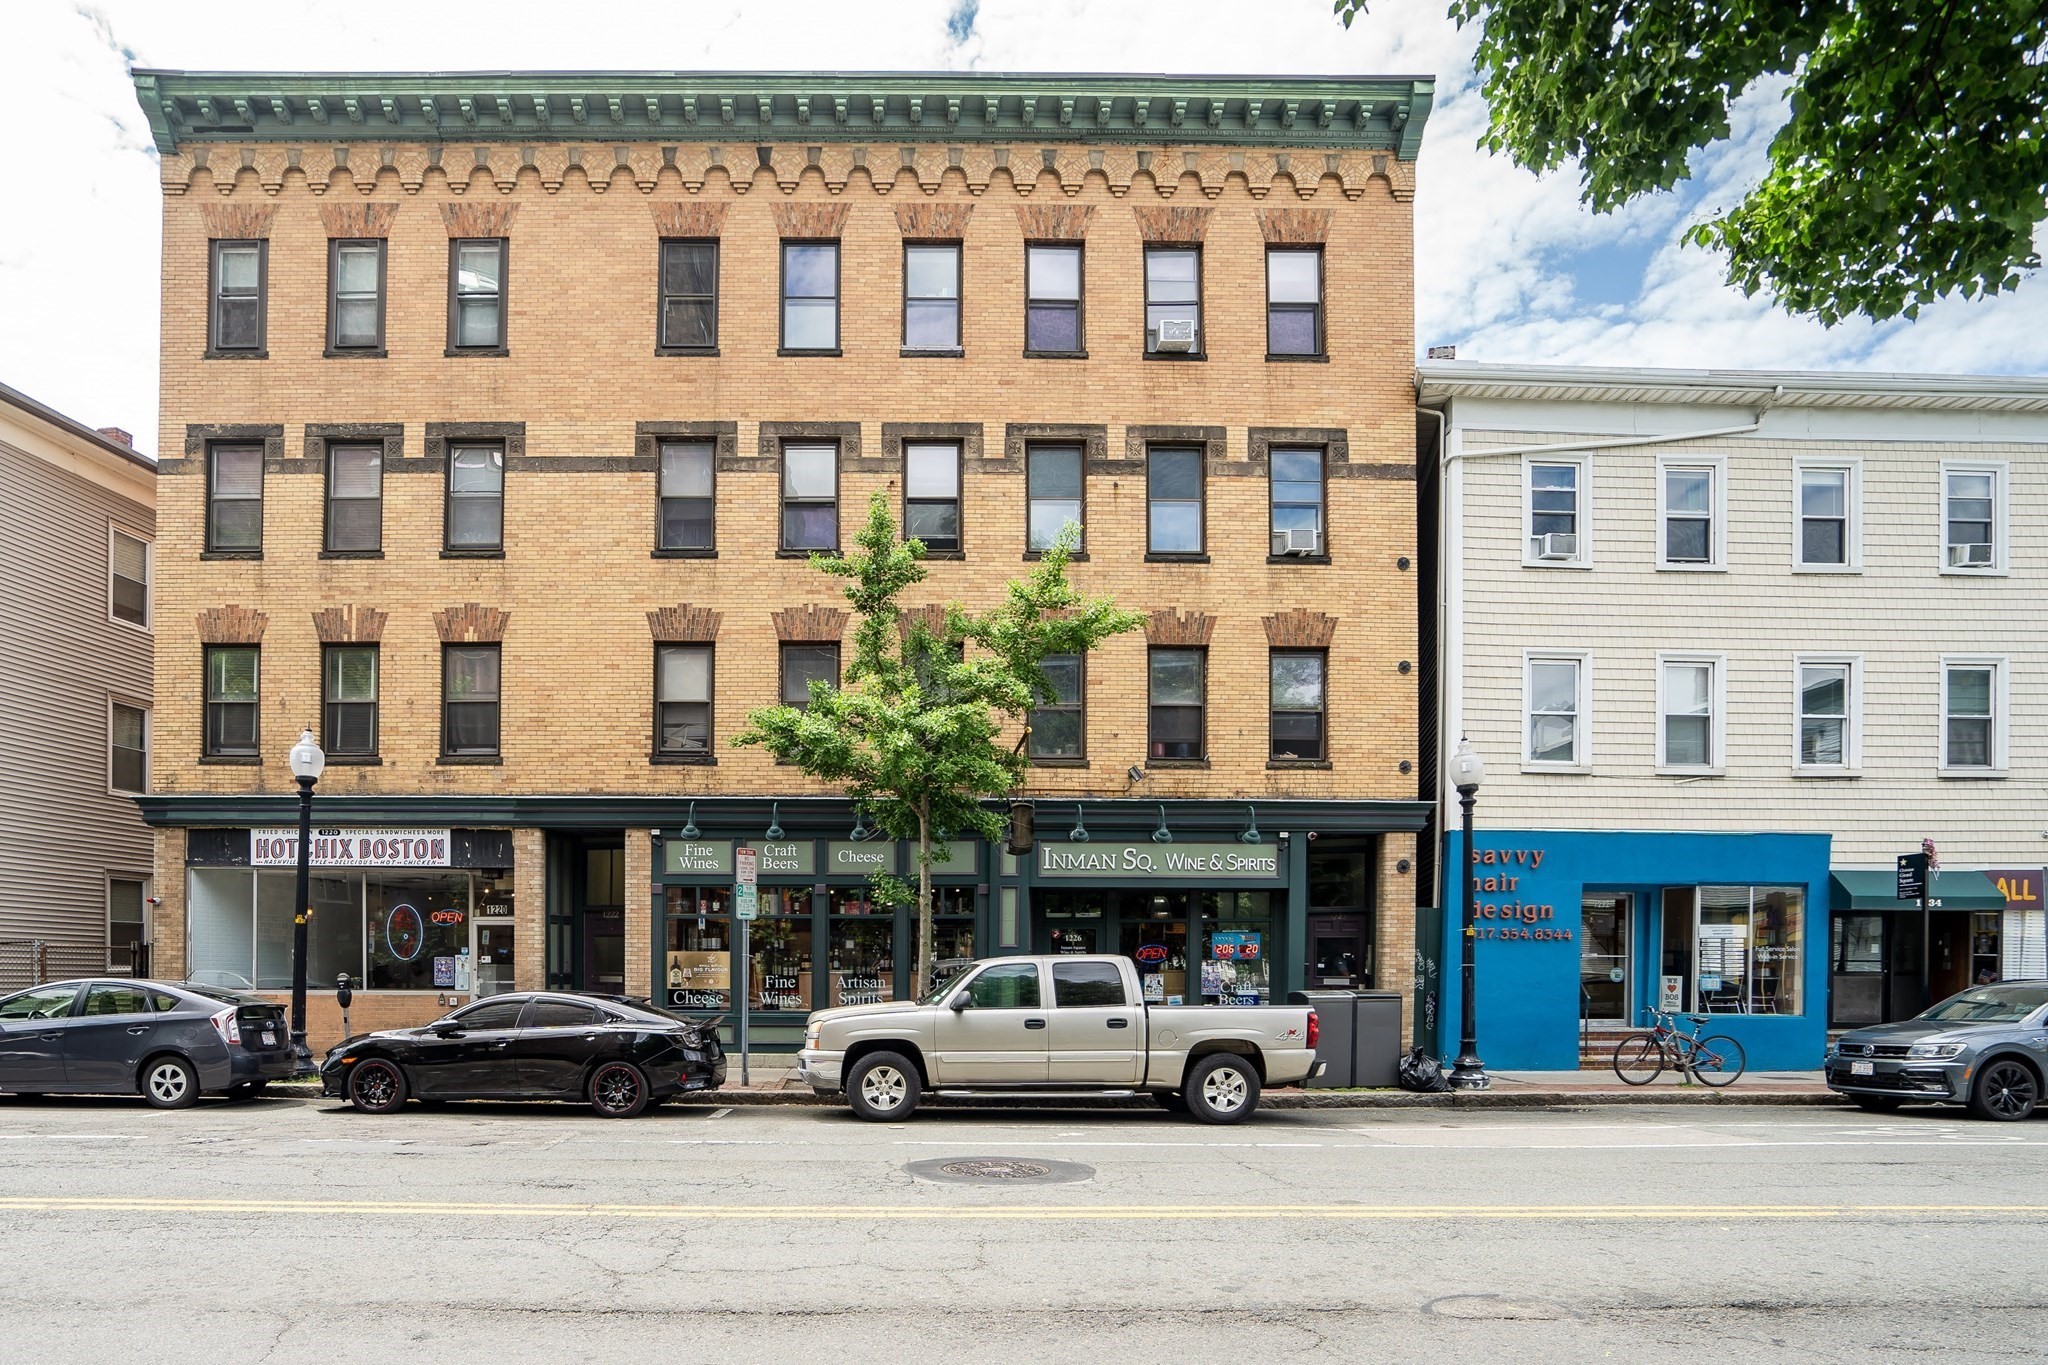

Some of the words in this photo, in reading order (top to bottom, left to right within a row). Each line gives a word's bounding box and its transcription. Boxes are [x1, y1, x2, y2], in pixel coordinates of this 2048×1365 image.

[256, 838, 299, 859] HOT
[360, 838, 445, 859] BOSTON
[685, 844, 714, 857] Fine
[764, 844, 797, 857] Craft
[680, 856, 719, 869] Wines
[762, 857, 799, 870] Beers
[838, 850, 885, 864] Cheese
[1209, 853, 1223, 871] &
[1473, 849, 1545, 869] savvy
[738, 886, 743, 896] 2
[1997, 877, 2037, 902] ALL
[487, 905, 507, 914] 1220
[1916, 899, 1942, 907] 134
[431, 911, 463, 923] OPEN
[1065, 934, 1082, 942] 1226
[1135, 946, 1168, 960] OPEN
[1216, 944, 1235, 954] 206
[1245, 944, 1259, 954] 20
[765, 975, 796, 989] Fine
[835, 975, 886, 989] Artisan
[1220, 981, 1252, 993] Craft
[673, 990, 724, 1004] Cheese
[759, 992, 802, 1005] Wines
[838, 993, 884, 1006] Spirits
[1219, 994, 1254, 1006] Beers
